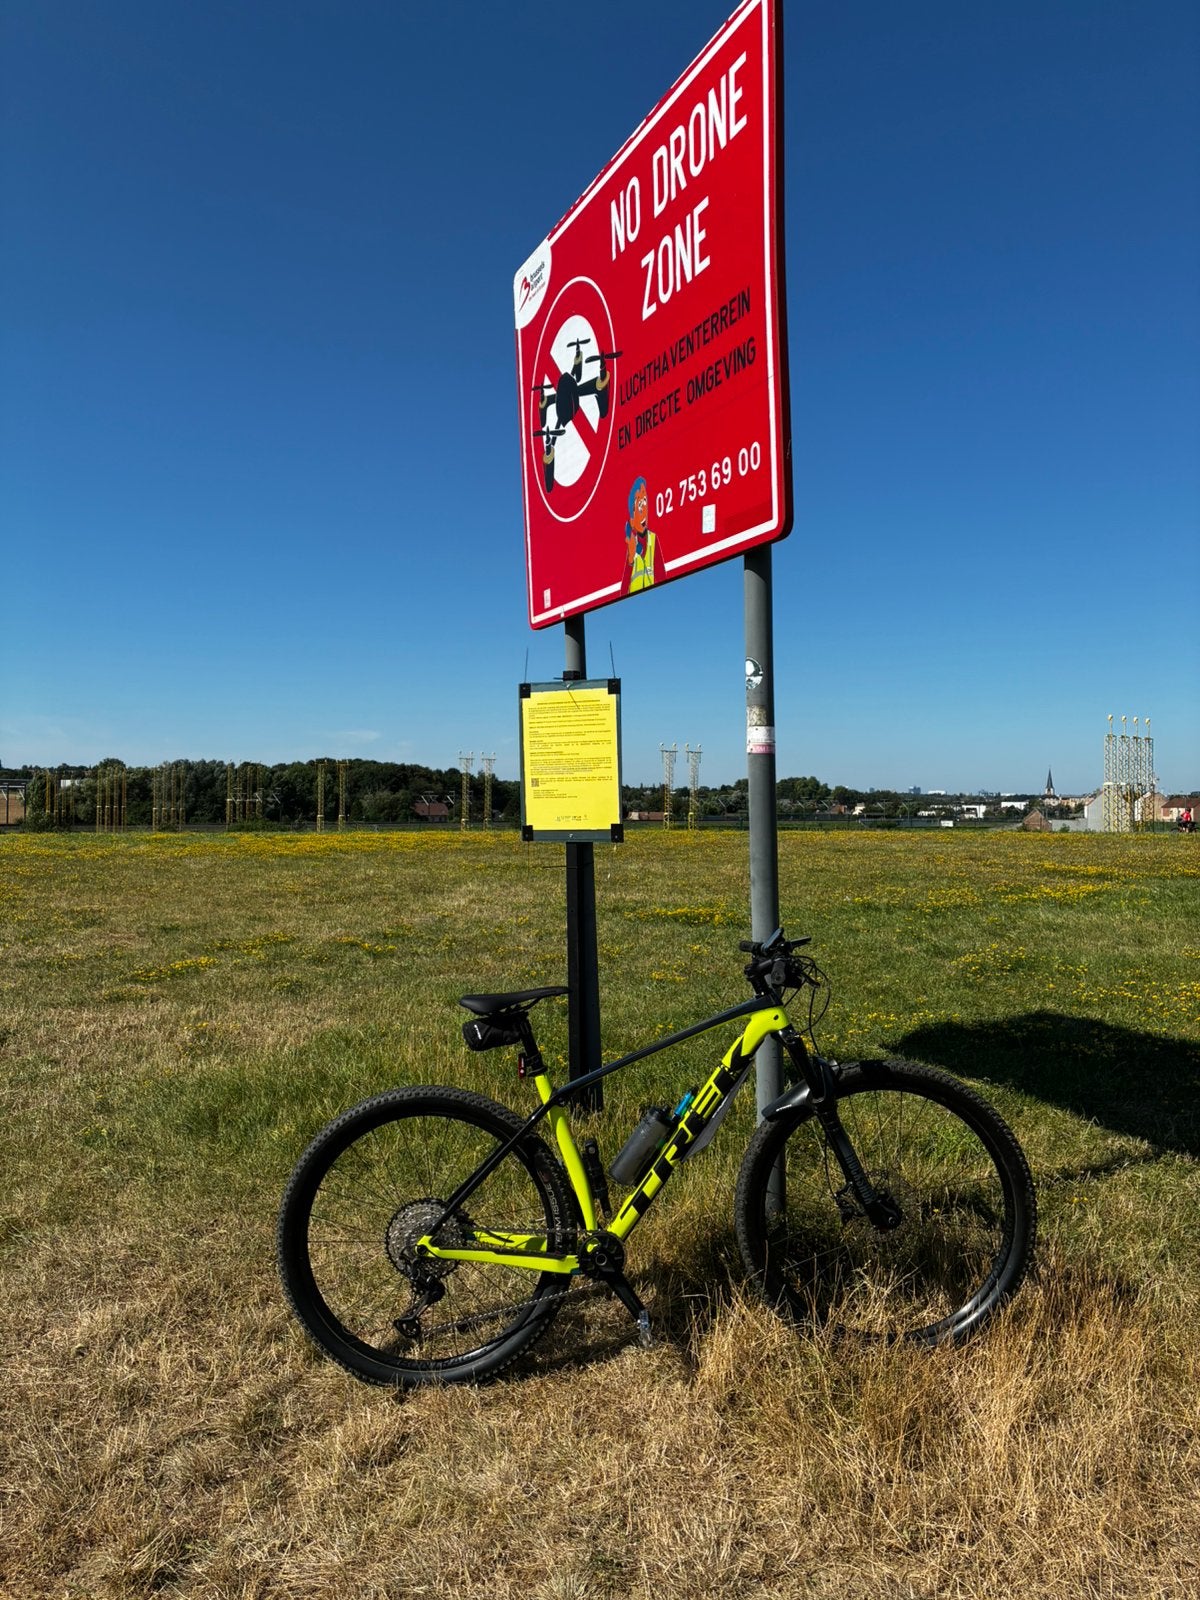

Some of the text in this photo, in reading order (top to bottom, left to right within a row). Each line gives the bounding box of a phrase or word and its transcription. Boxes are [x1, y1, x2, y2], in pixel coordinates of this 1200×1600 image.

[610, 51, 748, 261] NO DRONE
[640, 196, 711, 321] ZONE
[618, 337, 756, 450] EN DIRECTE OMGEVING
[619, 288, 751, 406] LUCHTHAVENTERREIN
[655, 441, 761, 518] 02 753 69 00
[619, 1035, 746, 1220] TREK
